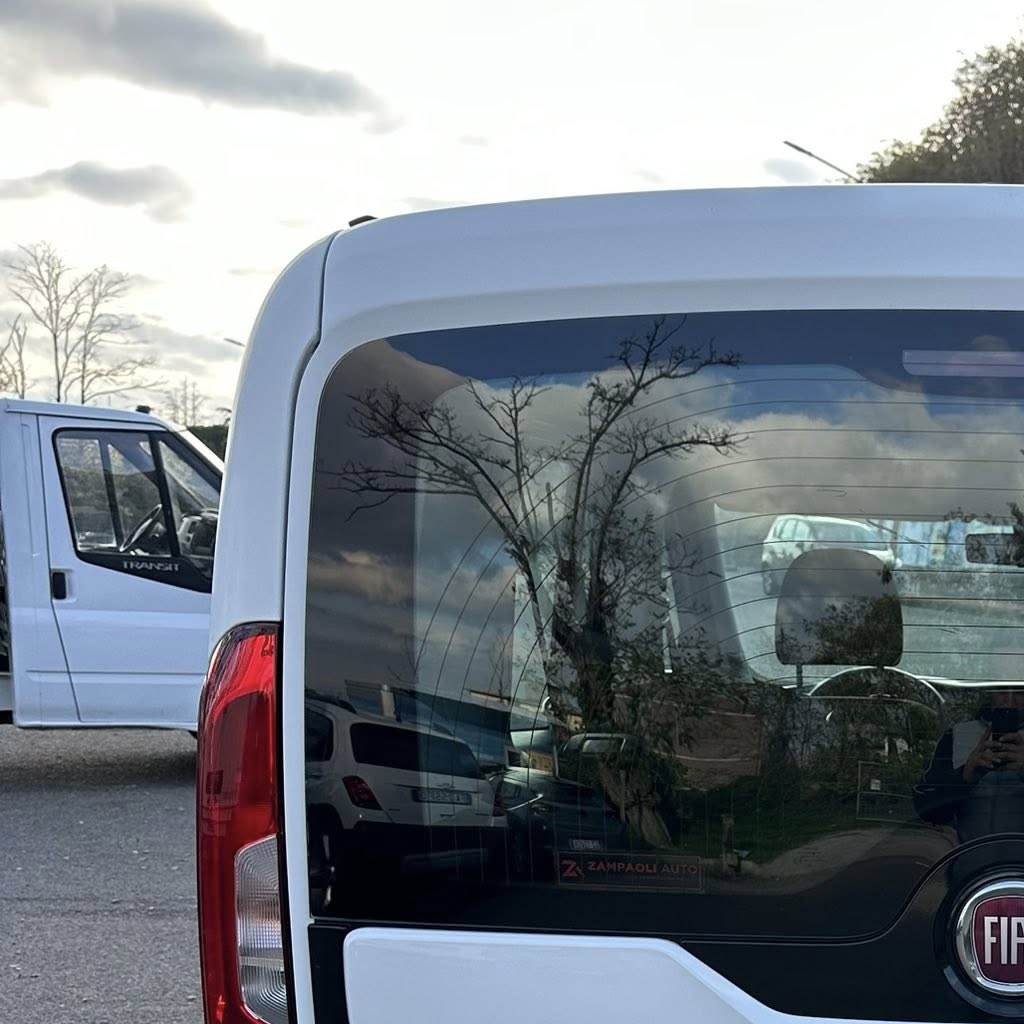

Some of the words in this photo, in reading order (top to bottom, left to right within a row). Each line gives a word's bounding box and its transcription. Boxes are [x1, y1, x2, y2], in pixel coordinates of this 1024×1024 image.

[123, 561, 180, 572] TRANSIT
[587, 860, 657, 874] ZAMPAOLI
[661, 863, 698, 875] AUTO
